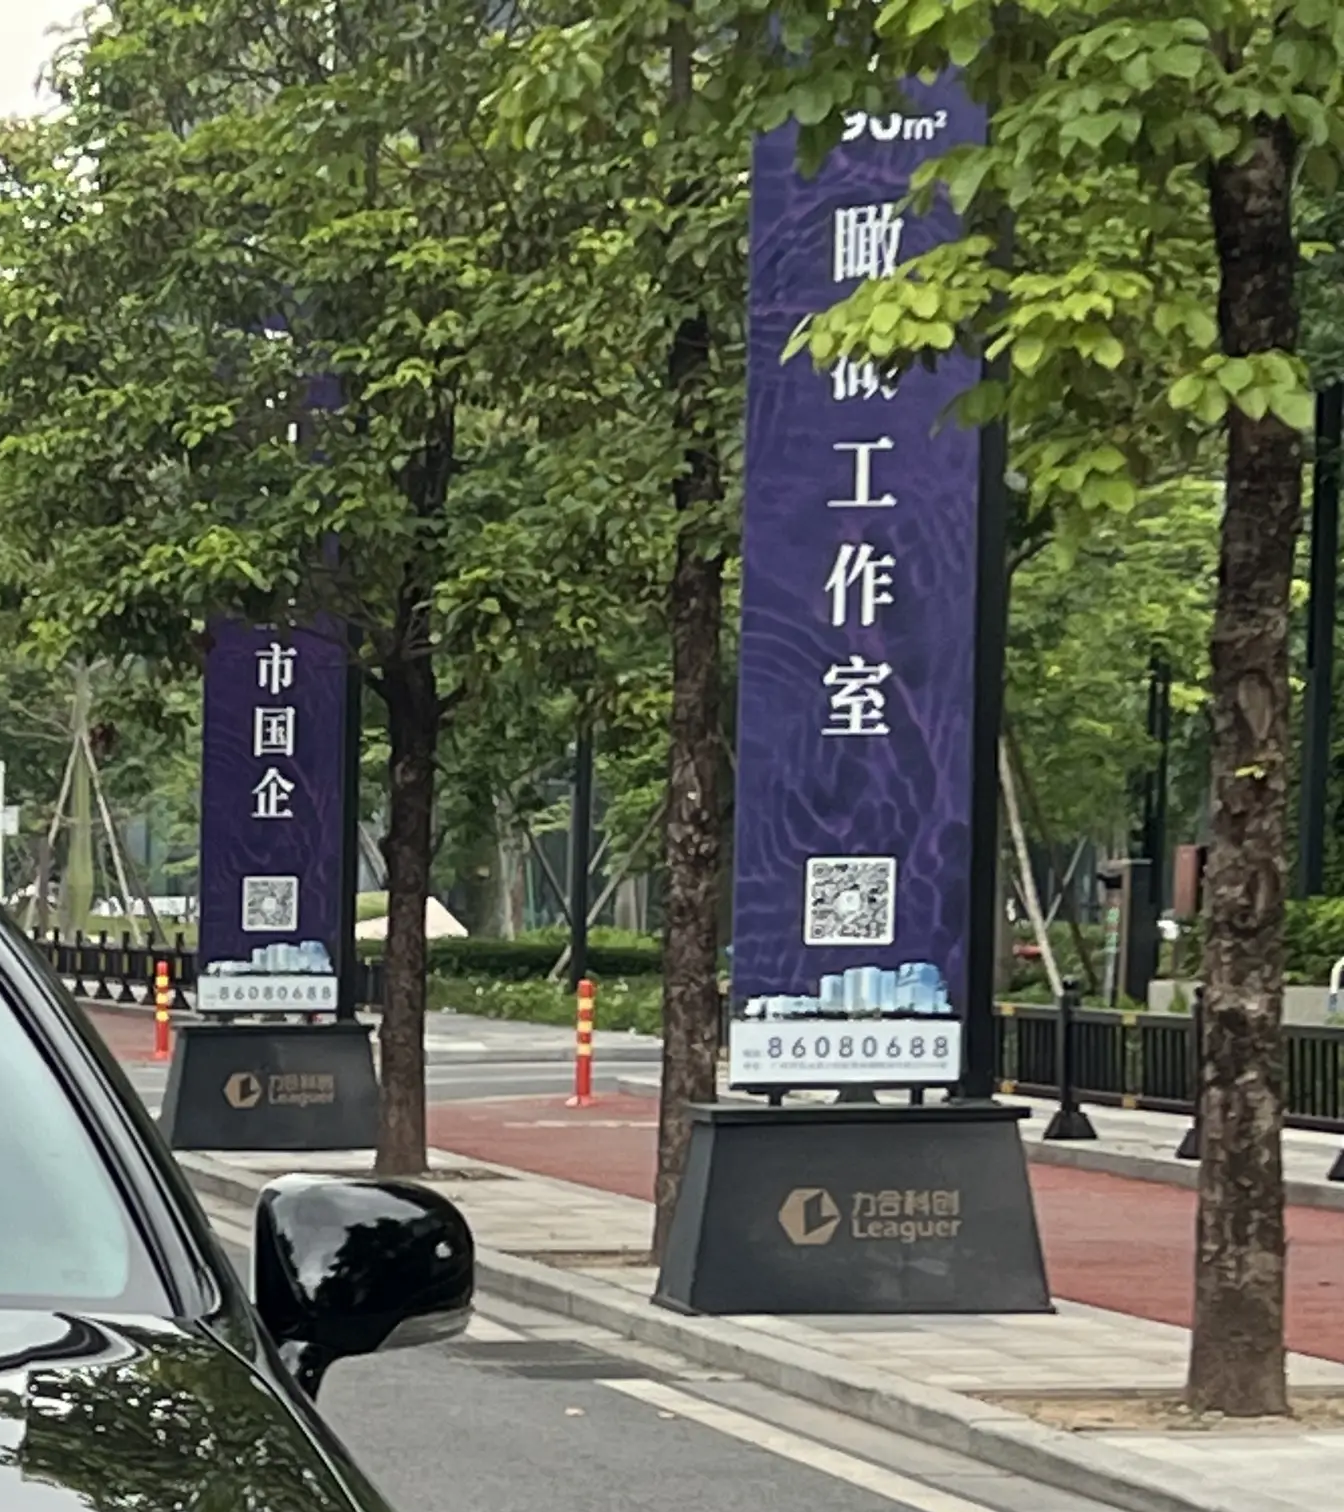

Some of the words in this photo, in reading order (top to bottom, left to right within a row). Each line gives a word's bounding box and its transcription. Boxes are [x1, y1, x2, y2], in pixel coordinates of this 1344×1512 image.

[218, 985, 332, 1001] 86080688
[766, 1036, 950, 1059] 86080688
[851, 1189, 961, 1218] 力合科创
[852, 1218, 962, 1244] Leaguer
